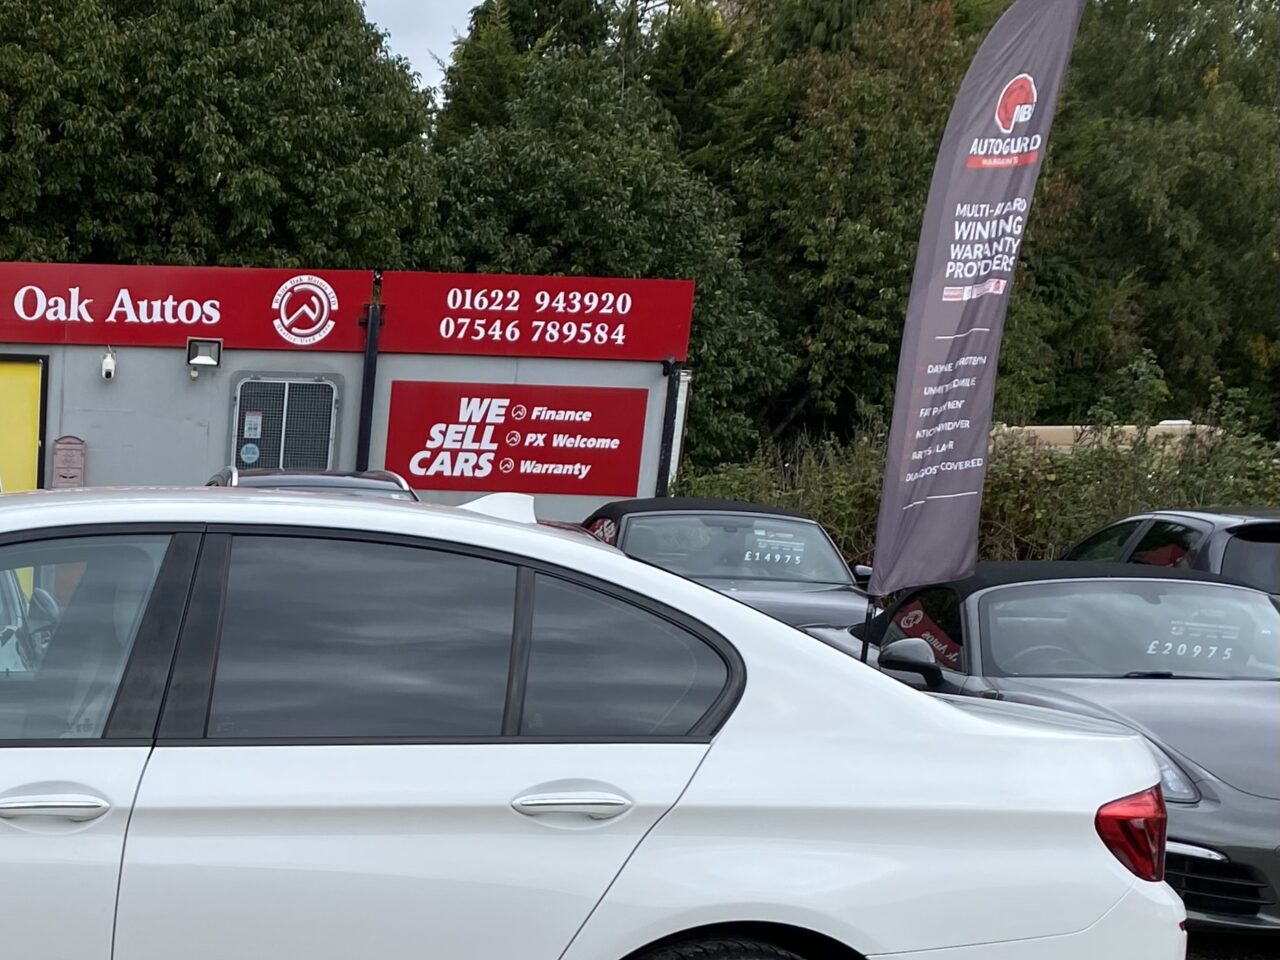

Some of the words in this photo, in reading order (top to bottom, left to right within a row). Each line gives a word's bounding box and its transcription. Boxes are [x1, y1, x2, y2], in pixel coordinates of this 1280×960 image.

[969, 134, 1042, 155] AUTOGURD
[954, 214, 1023, 240] WINING
[950, 237, 1021, 260] WARANTY
[274, 286, 289, 304] White
[289, 277, 304, 285] Oak
[307, 276, 328, 290] Motors
[328, 290, 337, 306] LTD
[447, 287, 520, 312] 01622
[535, 290, 632, 315] 943920
[13, 285, 94, 323] Oak
[106, 287, 221, 325] Autos
[439, 317, 520, 342] 07546
[531, 320, 626, 345] 789584
[459, 397, 510, 423] WE
[531, 406, 592, 422] Finance
[425, 424, 499, 450] SELL
[524, 433, 547, 447] PX
[552, 433, 620, 449] Welcome
[409, 450, 494, 477] CARS
[519, 460, 592, 479] Warranty
[940, 457, 984, 471] COVERED
[743, 551, 802, 566] £14975
[1146, 640, 1233, 660] £20975
